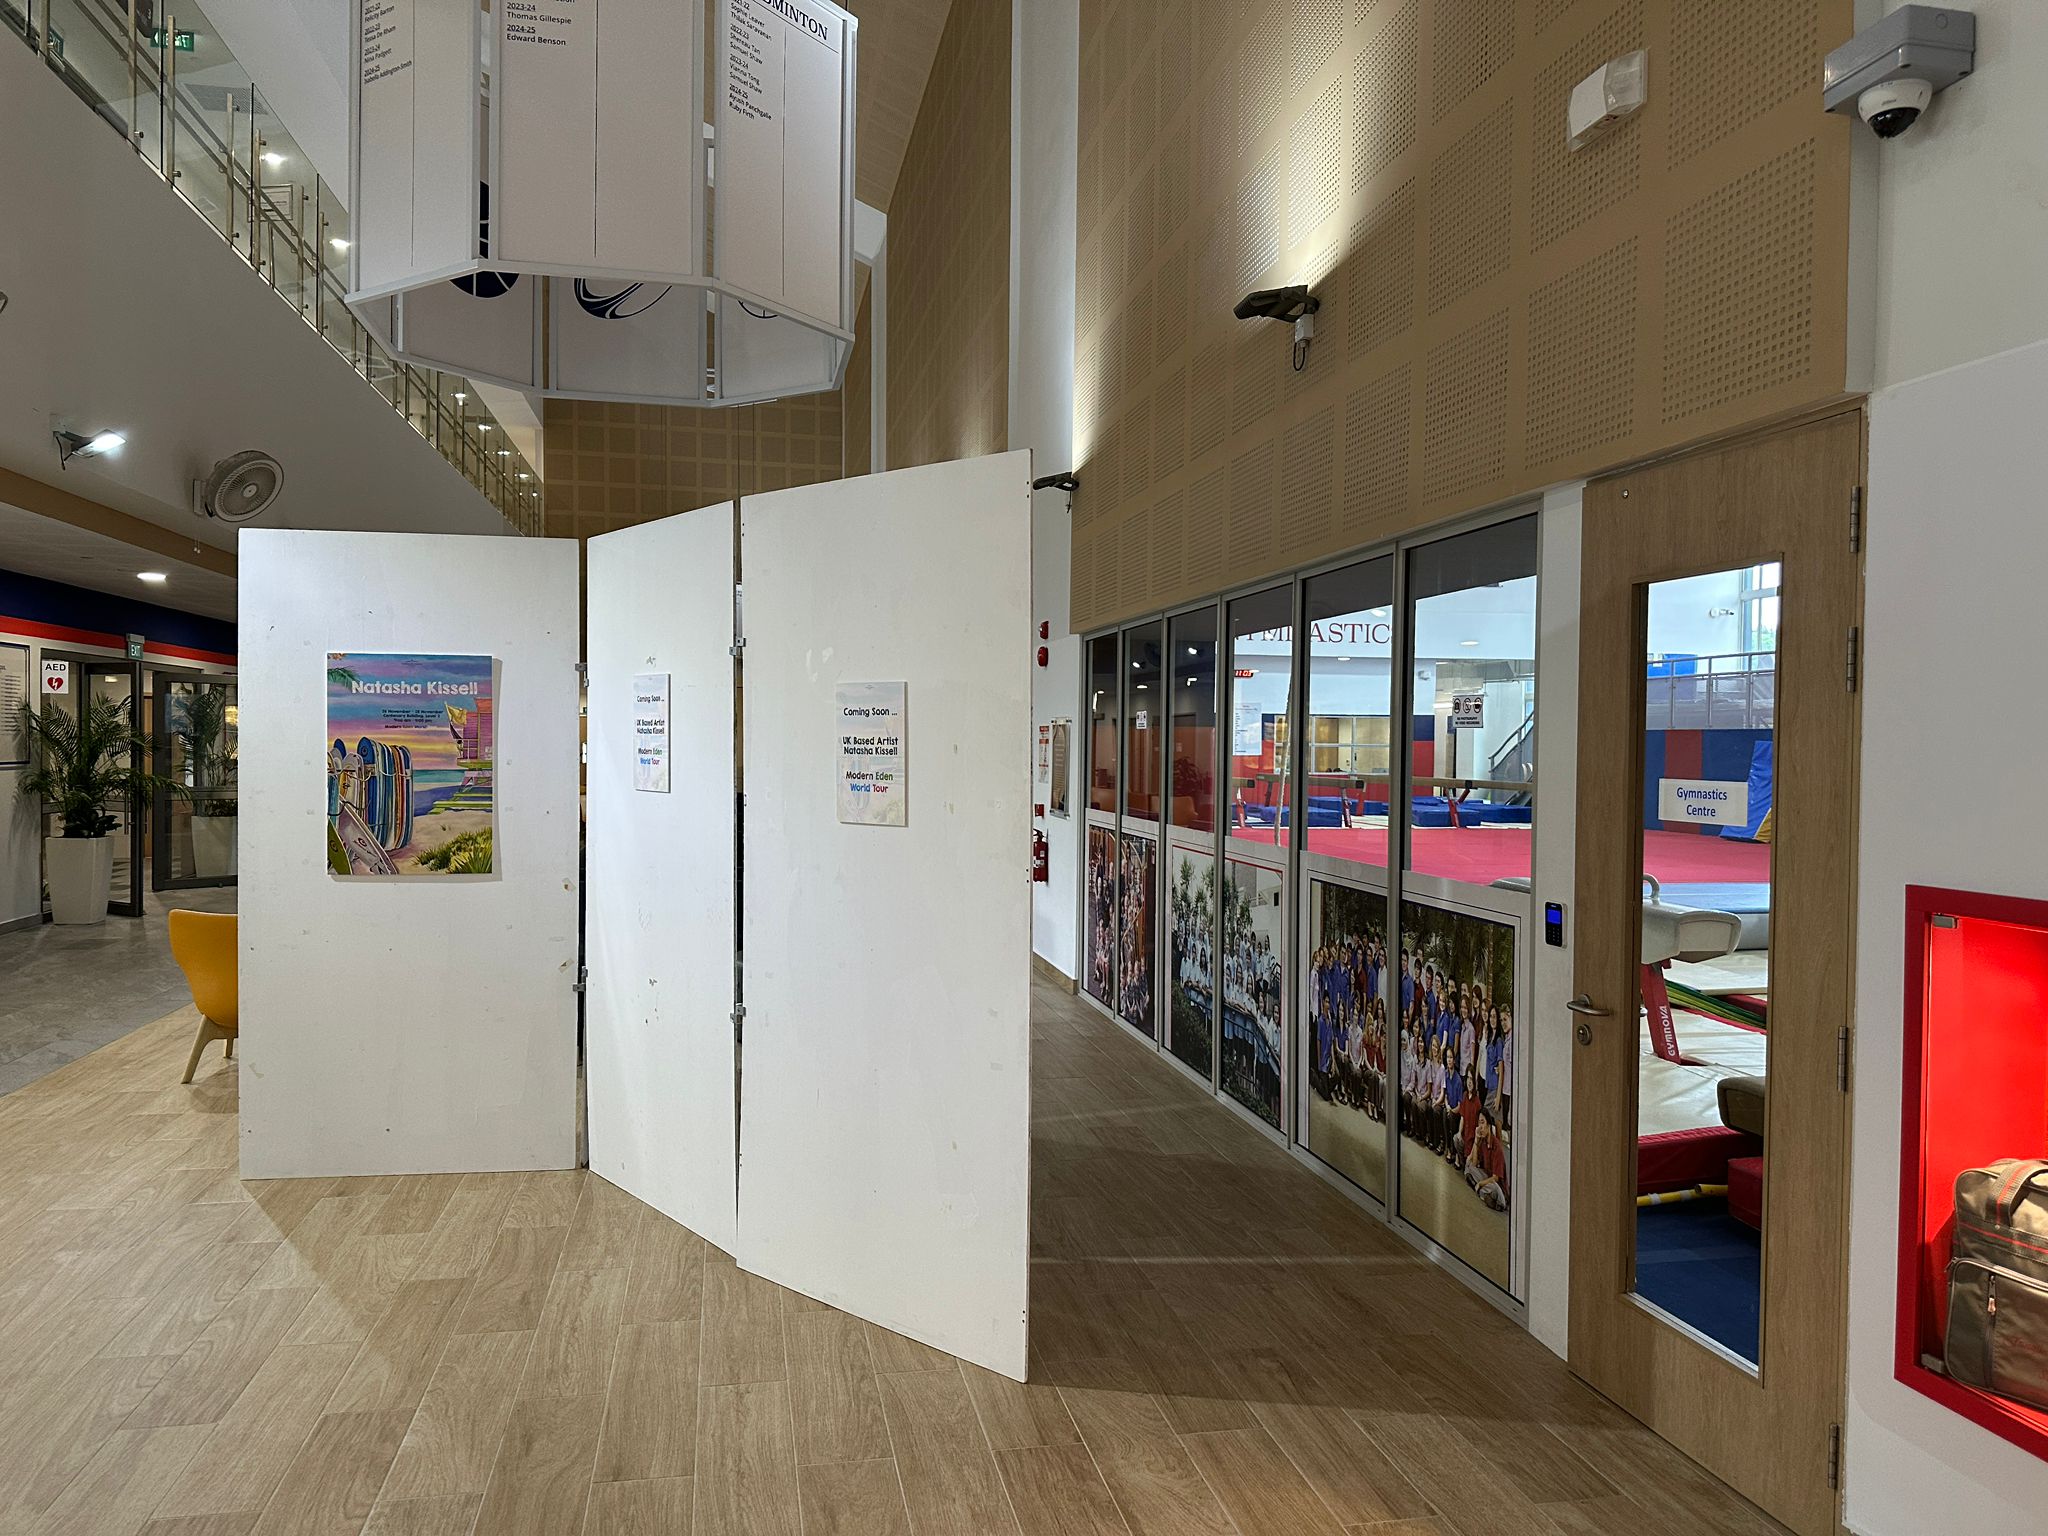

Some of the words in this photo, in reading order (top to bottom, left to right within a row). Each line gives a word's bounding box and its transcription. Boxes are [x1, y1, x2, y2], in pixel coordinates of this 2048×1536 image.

[506, 2, 536, 12] 2023-24
[507, 12, 538, 20] Thomas
[540, 14, 572, 24] Gillespie
[506, 24, 536, 34] 2024-25
[506, 34, 536, 42] Edward
[538, 36, 566, 46] Benson
[730, 42, 748, 56] Samuel
[750, 52, 762, 64] Shaw
[730, 54, 748, 69] 2023-24
[730, 72, 748, 86] Samuel
[749, 82, 762, 94] Shaw
[730, 84, 748, 98] 2024-25
[729, 100, 742, 114] Ruby
[742, 108, 754, 120] Firth
[352, 681, 422, 694] Natasha
[427, 682, 478, 695] Kissell
[636, 696, 650, 704] Coming
[844, 708, 870, 718] Coming
[872, 708, 890, 716] Soon
[842, 736, 852, 744] UK
[854, 736, 874, 746] Based
[876, 736, 898, 746] Artist
[844, 746, 873, 755] Natasha
[875, 746, 898, 755] Kissell
[846, 771, 874, 780] Modern
[876, 772, 894, 780] Eden
[850, 783, 870, 792] World
[872, 784, 888, 793] Tour
[1676, 787, 1728, 800] Gymnastics
[1686, 804, 1716, 816] Centre
